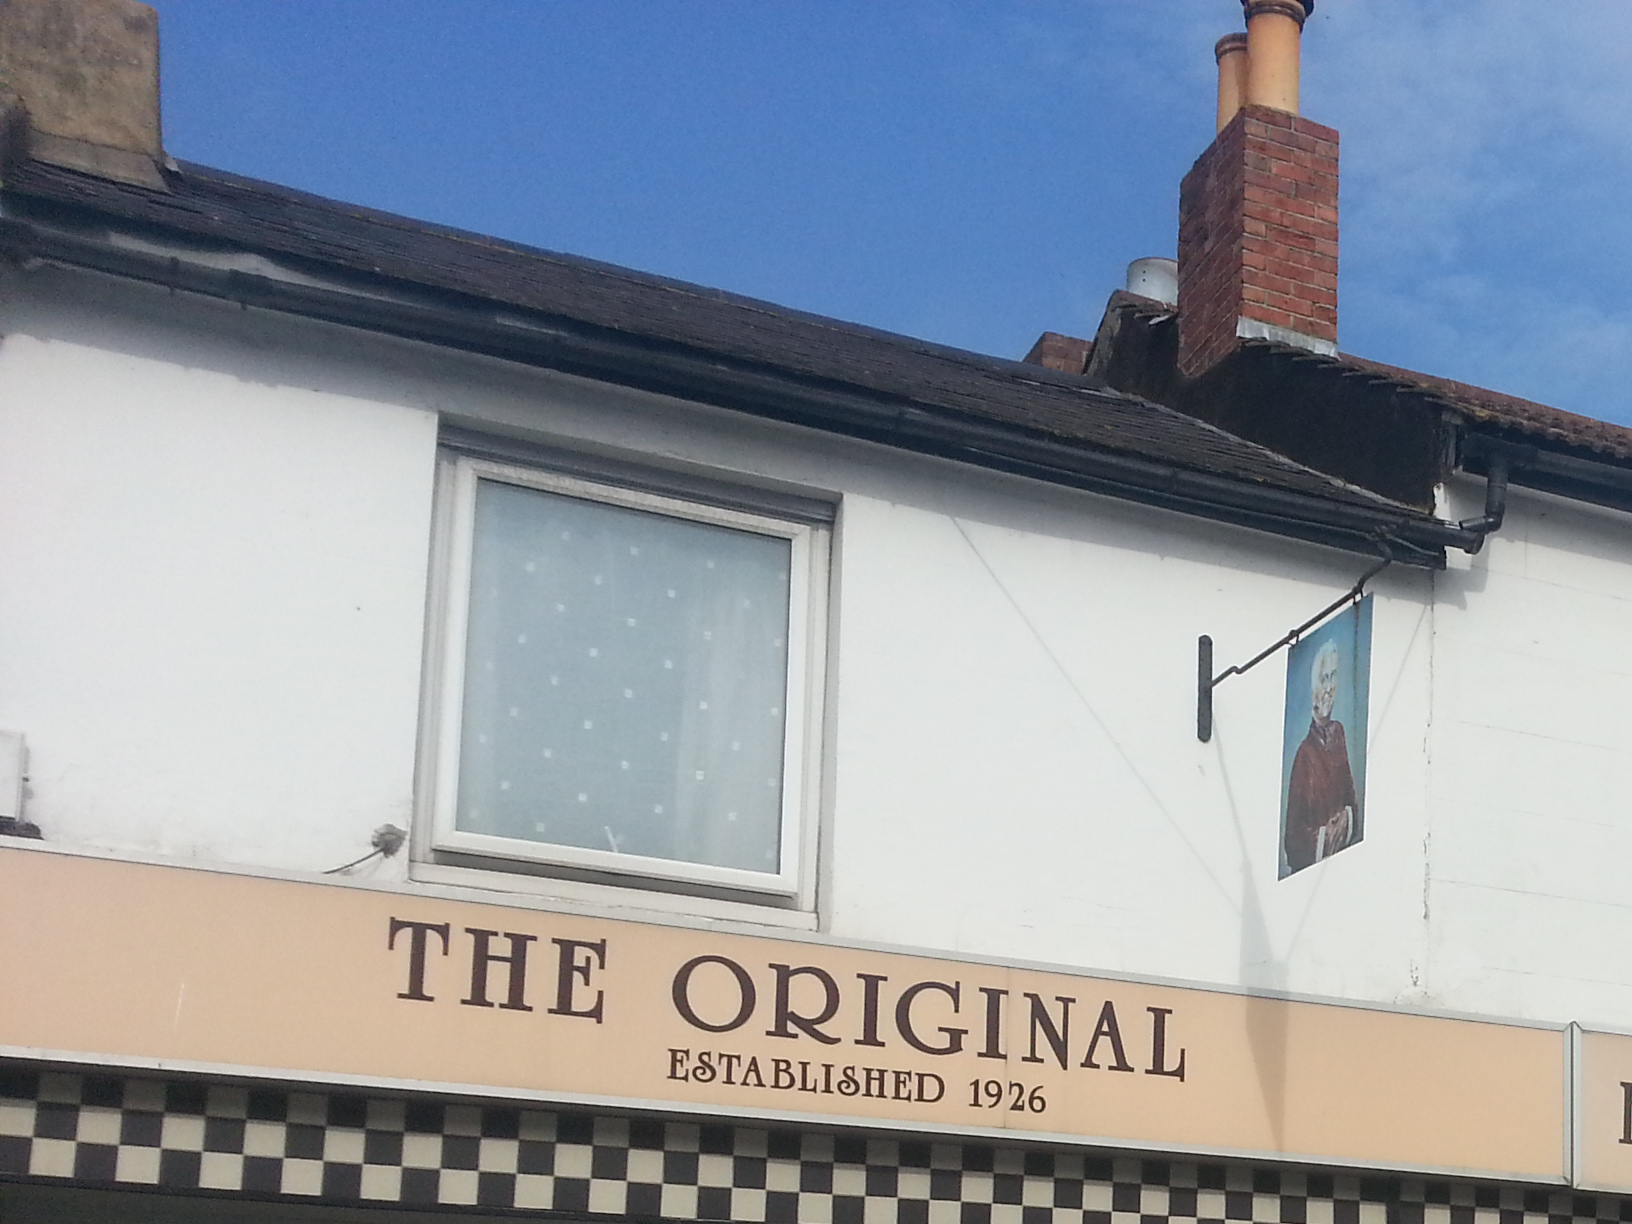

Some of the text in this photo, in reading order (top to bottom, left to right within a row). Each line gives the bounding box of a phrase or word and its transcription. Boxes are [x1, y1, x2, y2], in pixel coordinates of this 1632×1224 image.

[389, 916, 1186, 1082] THE ORIGINAL
[667, 1049, 1047, 1113] ESTABLISHED 1926
